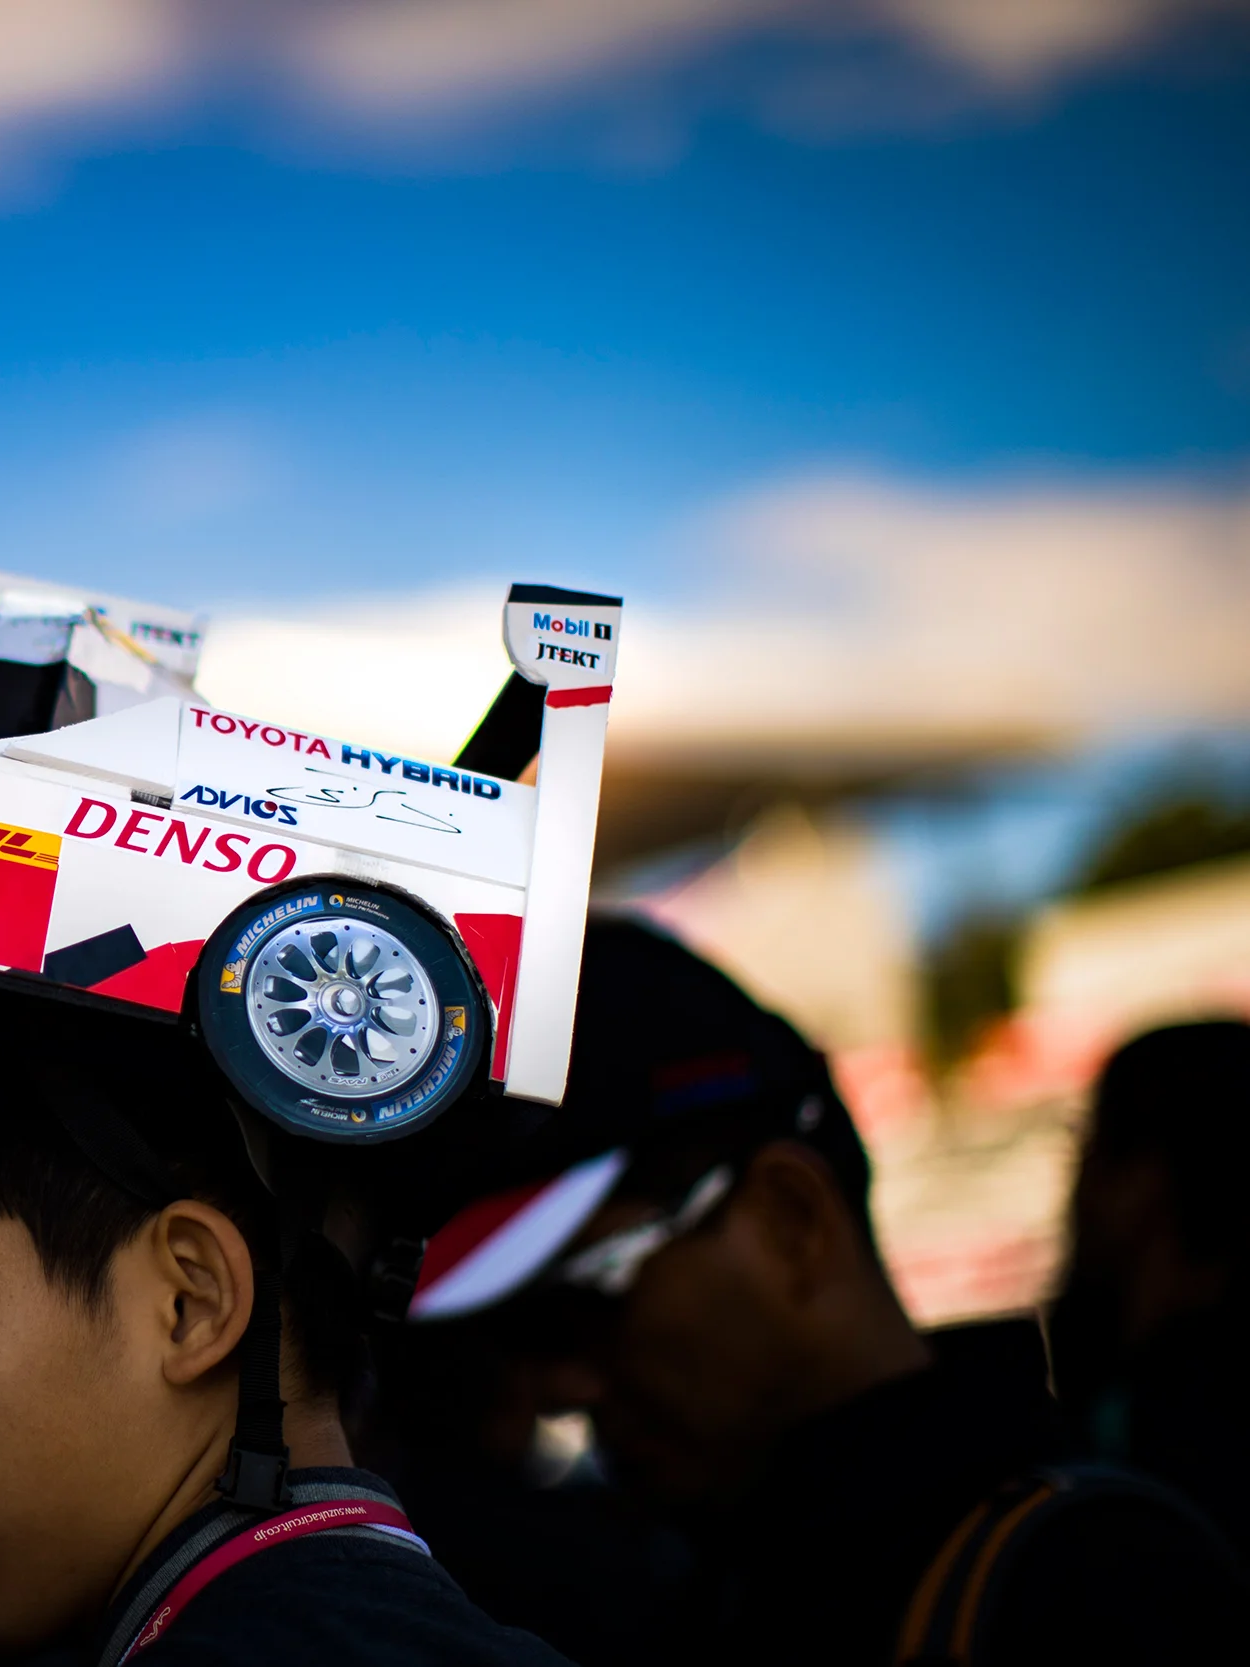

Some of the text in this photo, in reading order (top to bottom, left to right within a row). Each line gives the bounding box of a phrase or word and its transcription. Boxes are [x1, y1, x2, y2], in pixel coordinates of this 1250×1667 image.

[533, 612, 589, 637] Mobil
[536, 642, 600, 669] JTEKT
[189, 707, 332, 760] TOYOTA
[341, 744, 501, 801] HYBRID
[63, 797, 296, 884] DENSO
[344, 902, 390, 921] Total Performance
[345, 896, 381, 910] MICHELIN
[236, 895, 318, 957] MICHELIN
[379, 1044, 457, 1120] MICHELIN
[310, 1107, 349, 1121] MICHELIN
[253, 1505, 367, 1541] www.suzukacircuit.co.jp
